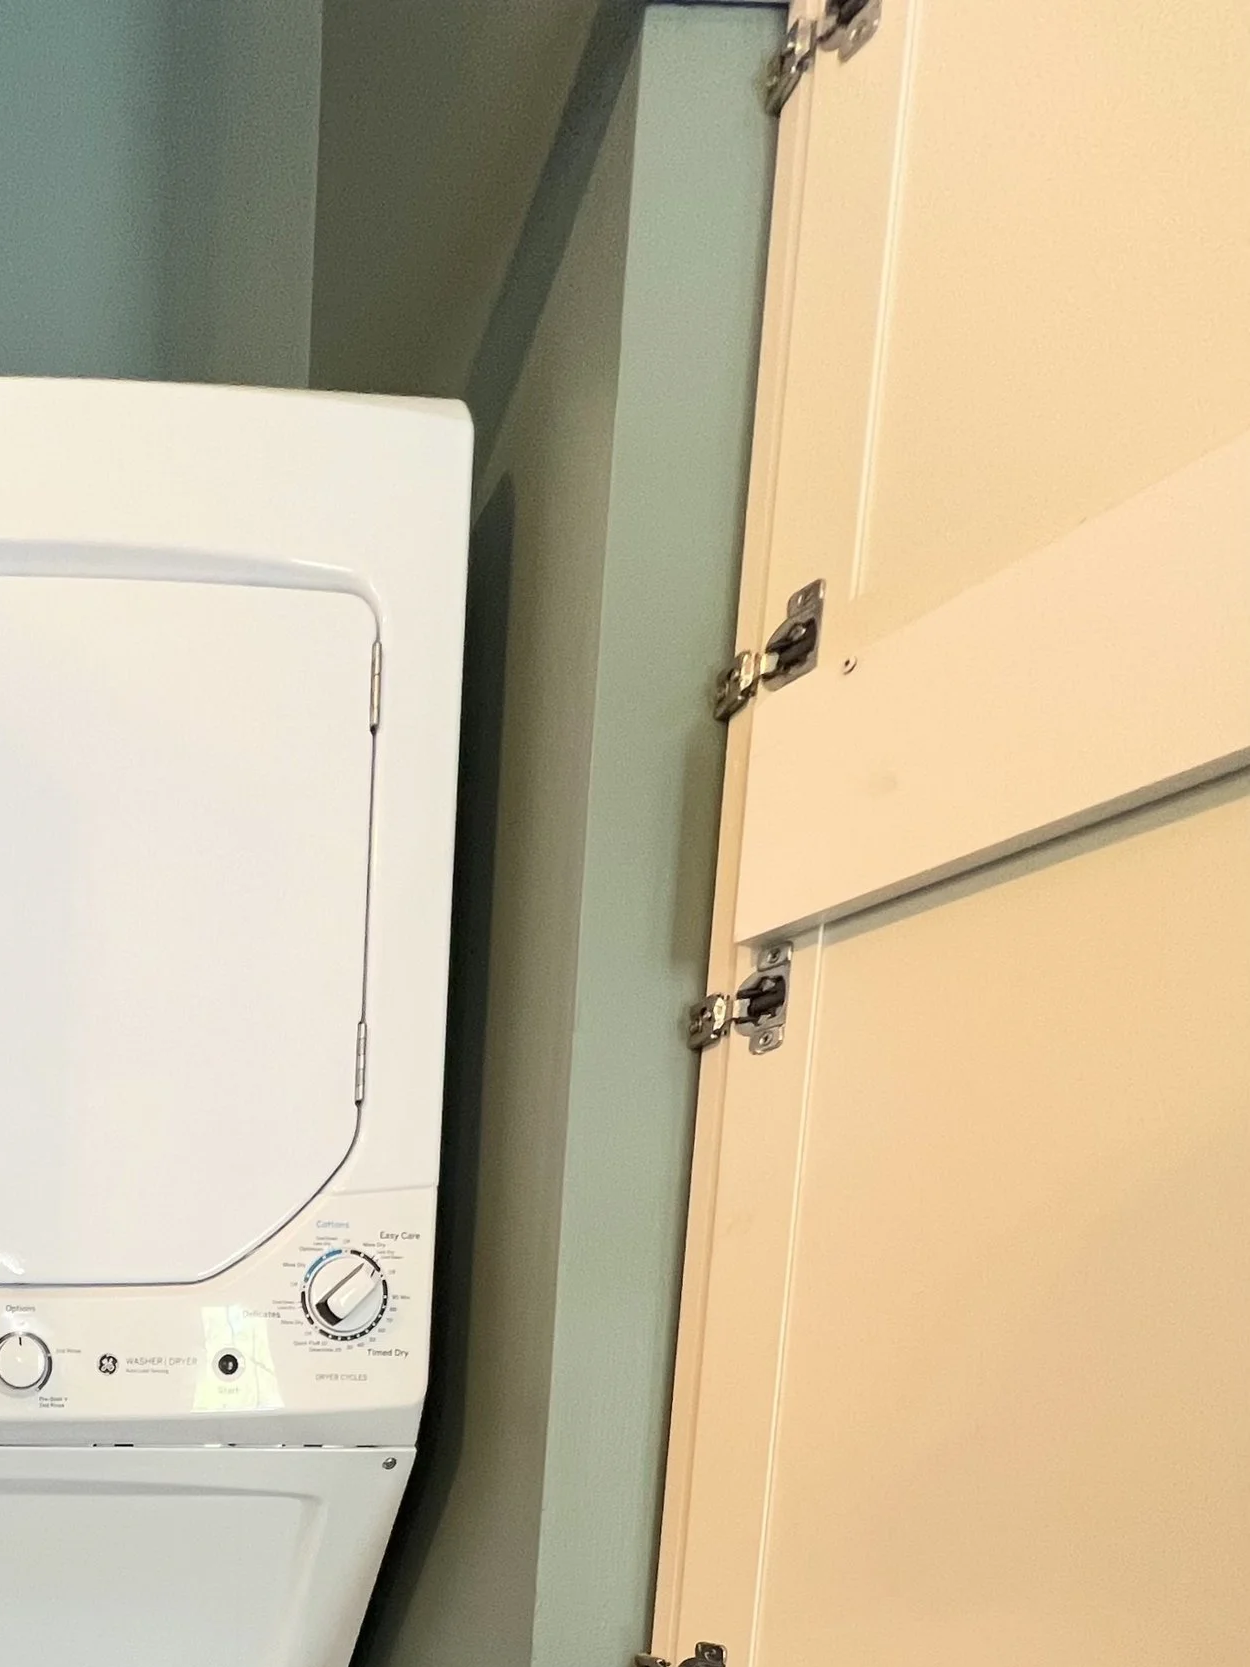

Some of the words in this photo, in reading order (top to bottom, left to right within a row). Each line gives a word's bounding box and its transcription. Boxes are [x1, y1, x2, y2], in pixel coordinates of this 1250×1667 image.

[316, 1220, 349, 1229] Cottons
[380, 1231, 399, 1241] Easy
[401, 1231, 420, 1240] Care
[5, 1305, 35, 1313] Options
[243, 1310, 281, 1319] Delicates
[367, 1349, 392, 1357] Timed
[394, 1348, 409, 1358] Dry
[126, 1357, 163, 1366] WASHER
[168, 1357, 198, 1366] DRYER
[217, 1386, 239, 1394] Start
